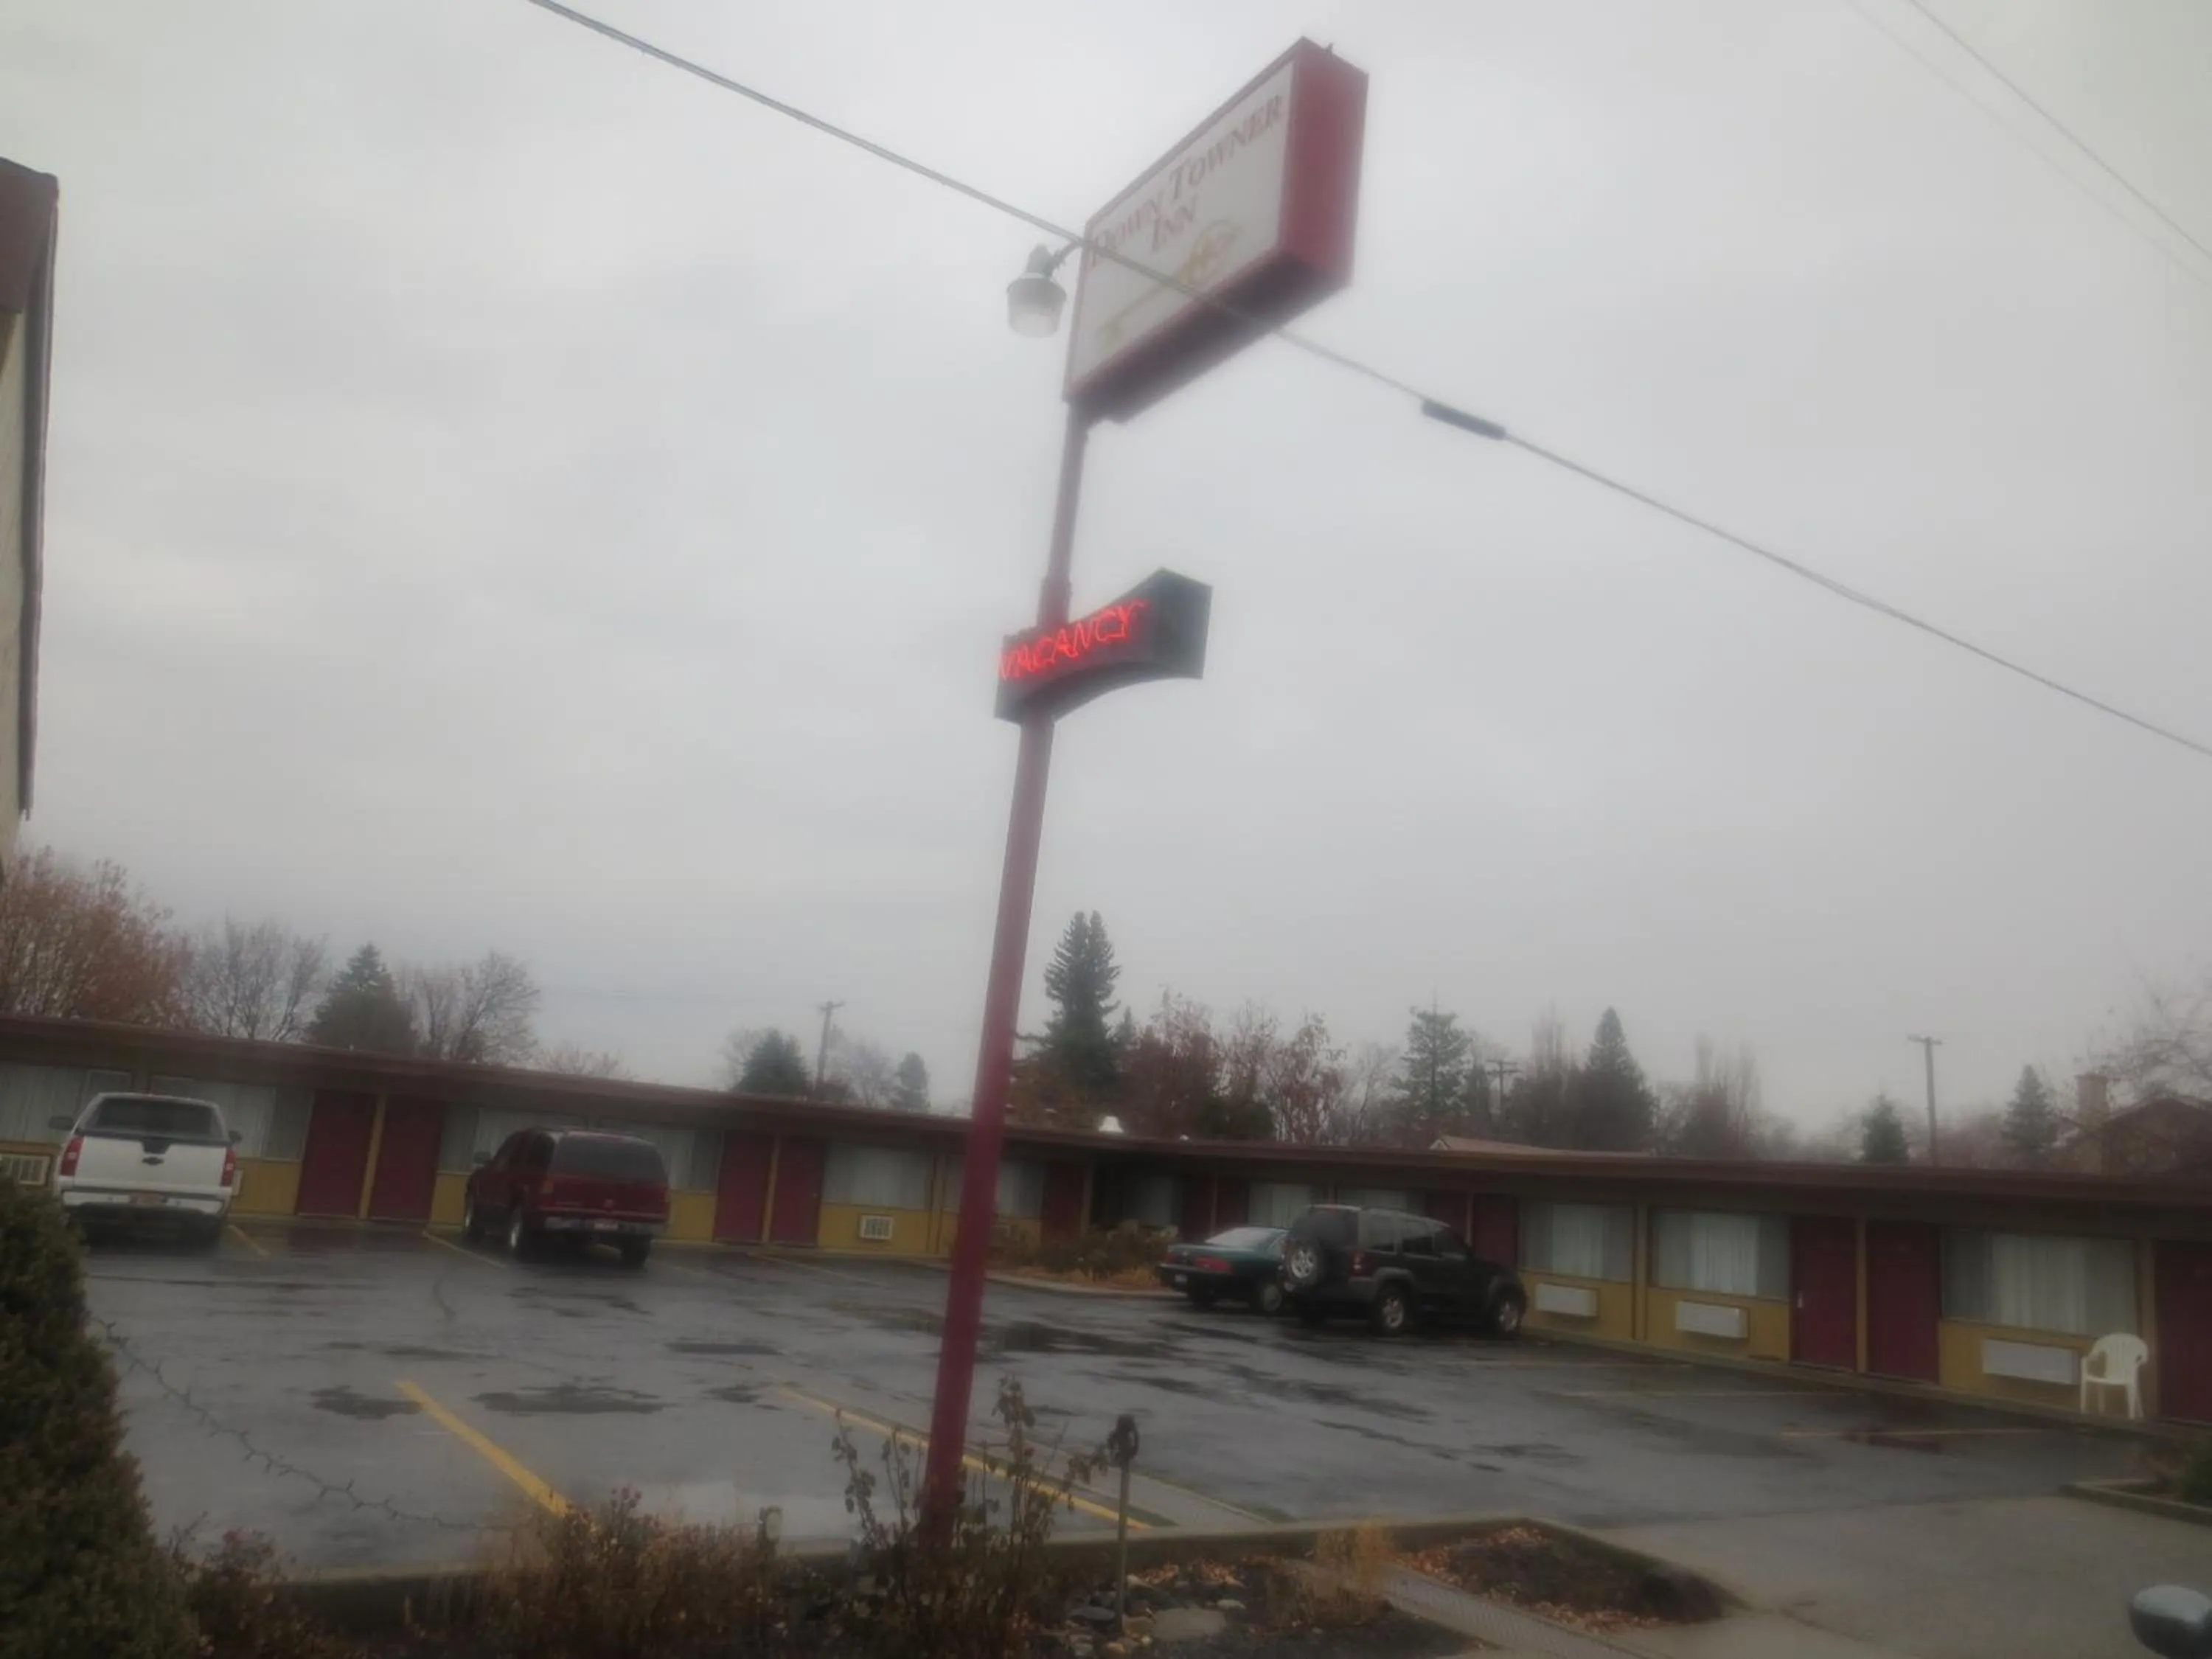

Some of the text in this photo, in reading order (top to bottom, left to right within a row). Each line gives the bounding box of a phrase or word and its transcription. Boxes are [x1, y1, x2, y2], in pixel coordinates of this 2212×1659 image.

[1169, 95, 1282, 200] TOWNER
[1151, 193, 1199, 252] INN
[1000, 599, 1146, 681] VACANCY
